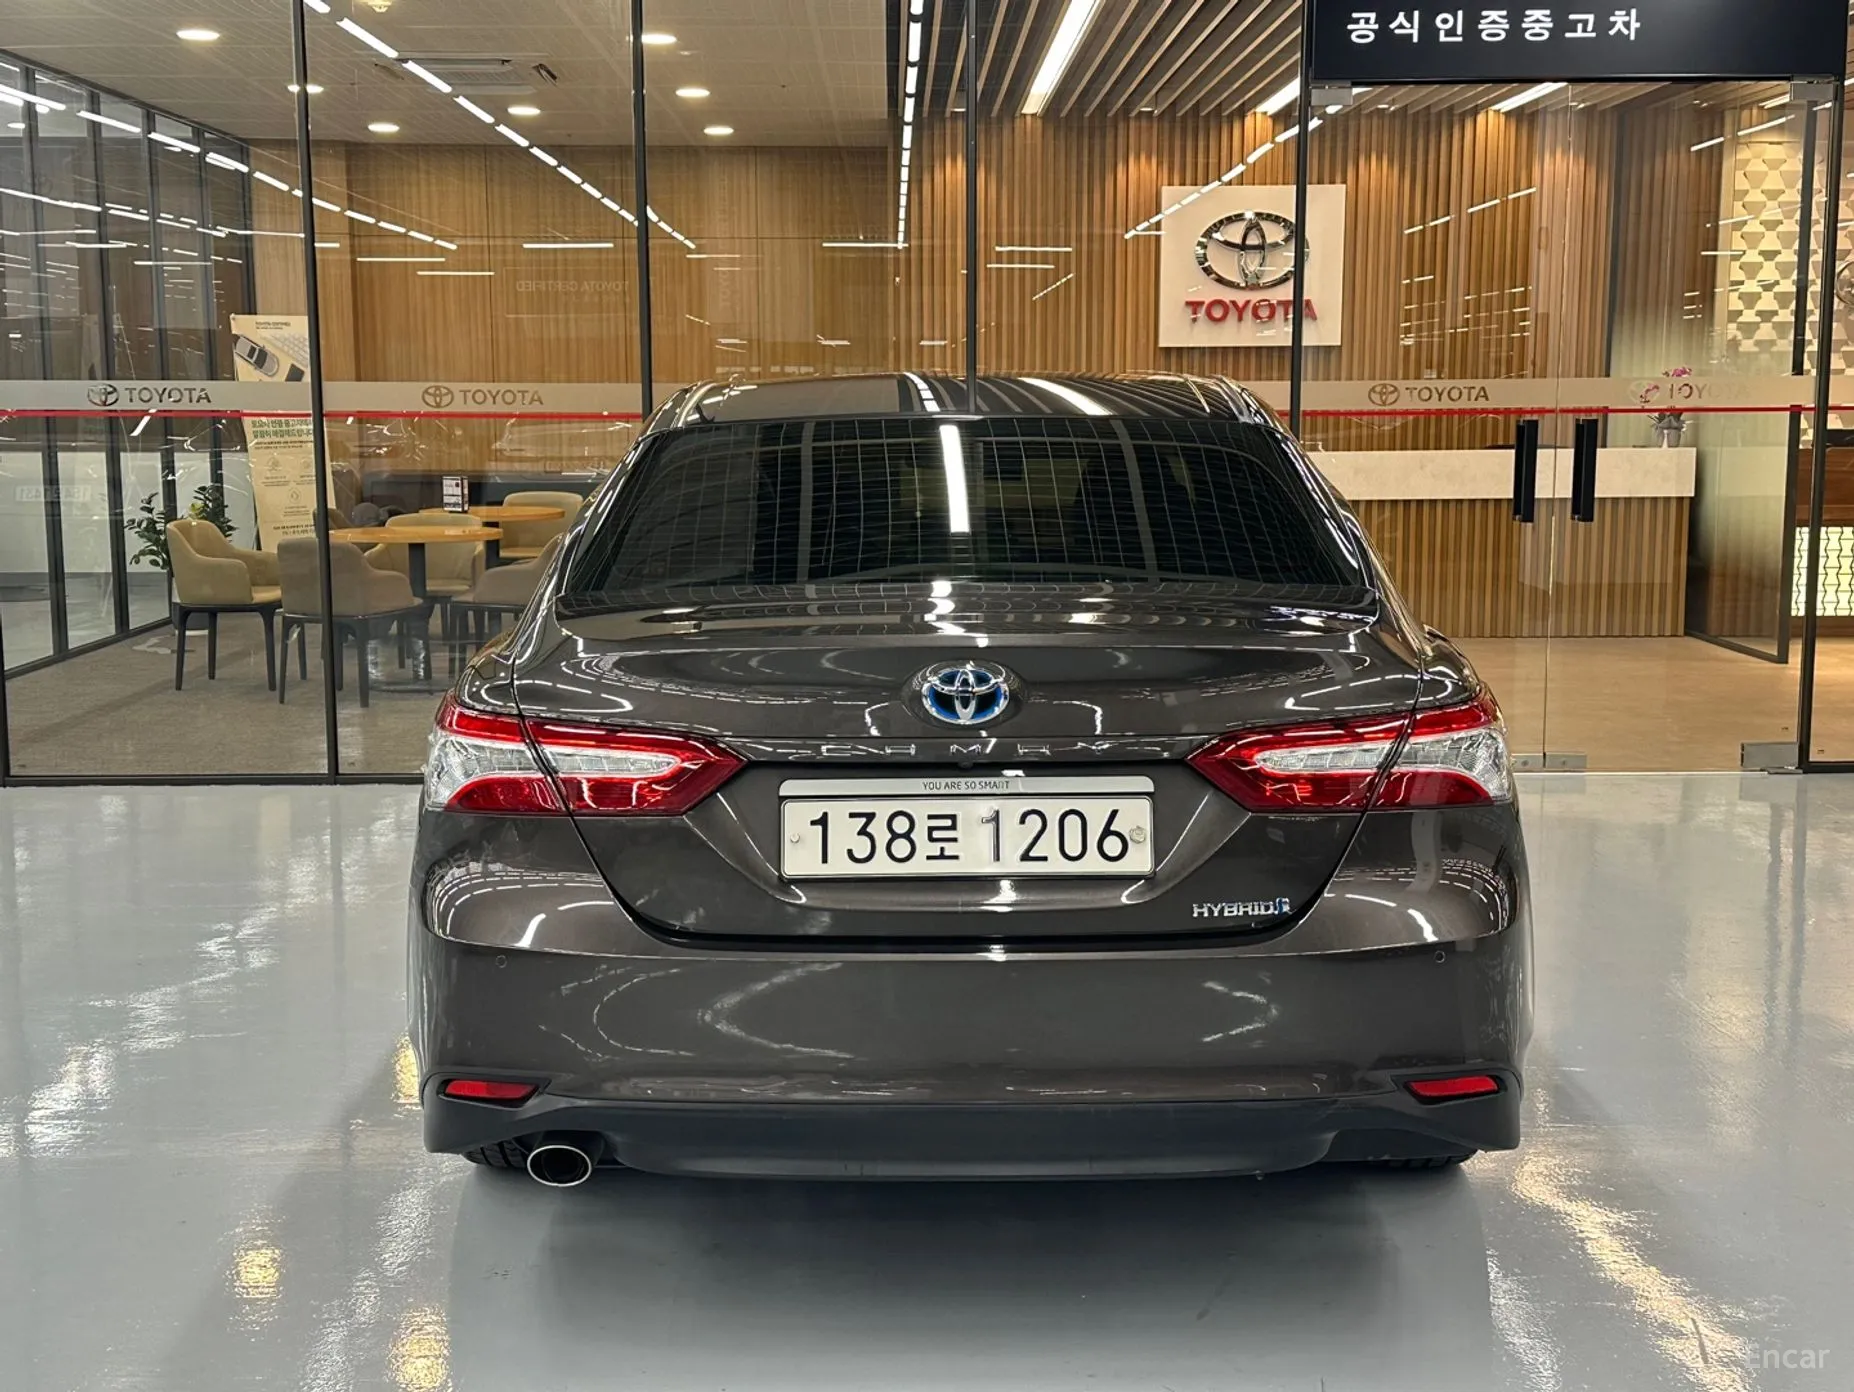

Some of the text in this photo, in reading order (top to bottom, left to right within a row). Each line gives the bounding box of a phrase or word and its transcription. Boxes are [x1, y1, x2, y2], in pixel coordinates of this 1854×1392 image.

[1185, 299, 1318, 324] TOYOTA
[125, 387, 212, 403] TOYOTA
[459, 389, 544, 405] TOYOTA
[1405, 386, 1490, 402] TOYOTA
[922, 781, 941, 791] YOU
[943, 781, 961, 790] ARE
[964, 780, 977, 790] SO
[809, 808, 1129, 864] 138로 1206
[1192, 900, 1275, 918] HYBRID
